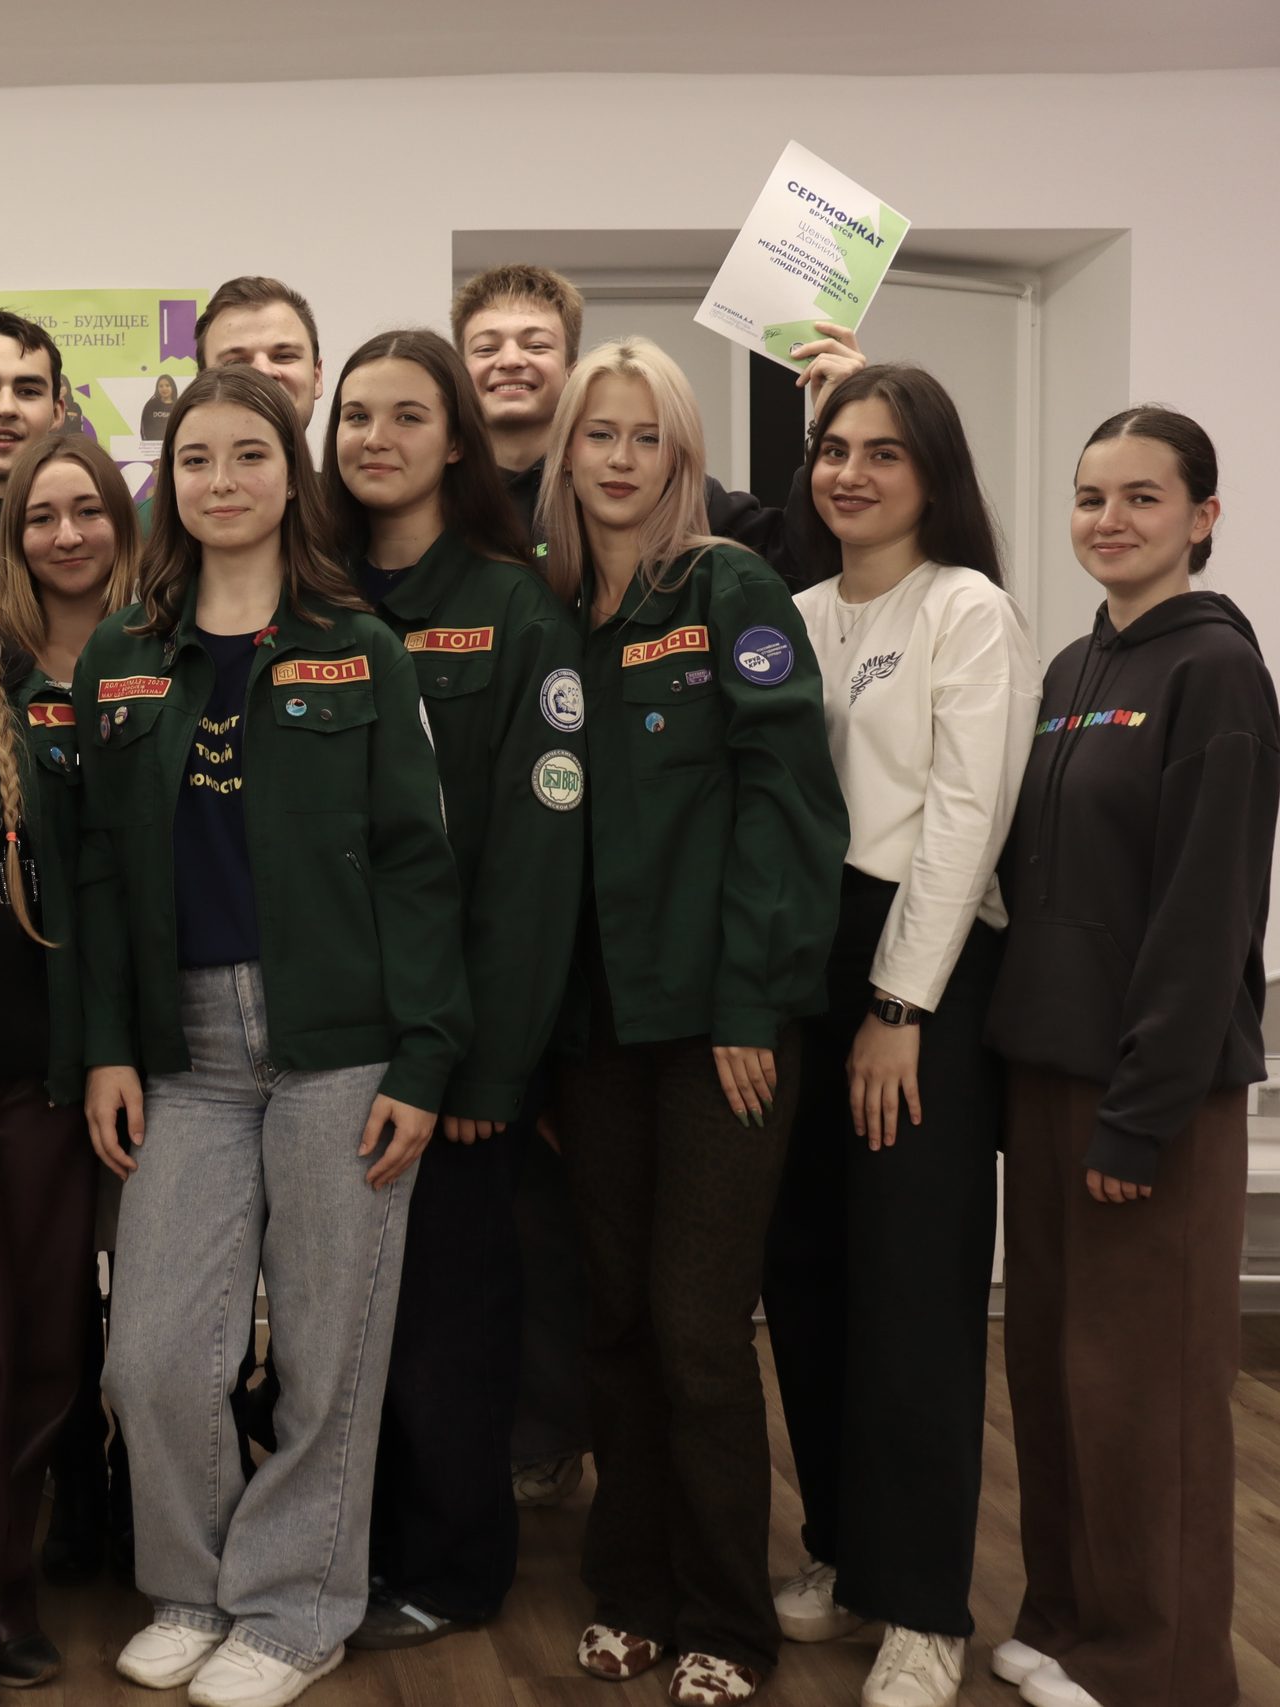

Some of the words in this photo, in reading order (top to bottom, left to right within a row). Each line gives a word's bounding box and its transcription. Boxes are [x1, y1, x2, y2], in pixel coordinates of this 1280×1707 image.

[787, 180, 885, 249] СЕРТИФИКАТ
[809, 208, 853, 240] ВРУЧАЕТСЯ
[757, 238, 820, 278] МЕДИАШКОЛЫ
[820, 272, 847, 296] ШТАБА
[847, 292, 859, 304] СО
[780, 239, 788, 247] О
[788, 242, 850, 286] ПРОХОЖДЕНИИ
[74, 314, 149, 329] БУДУЩЕЕ
[53, 333, 126, 347] СТРАНЫ!
[436, 632, 483, 649] ТОП
[743, 655, 761, 665] ТРУД
[748, 659, 766, 669] КРУТ
[306, 663, 358, 681] ТОП
